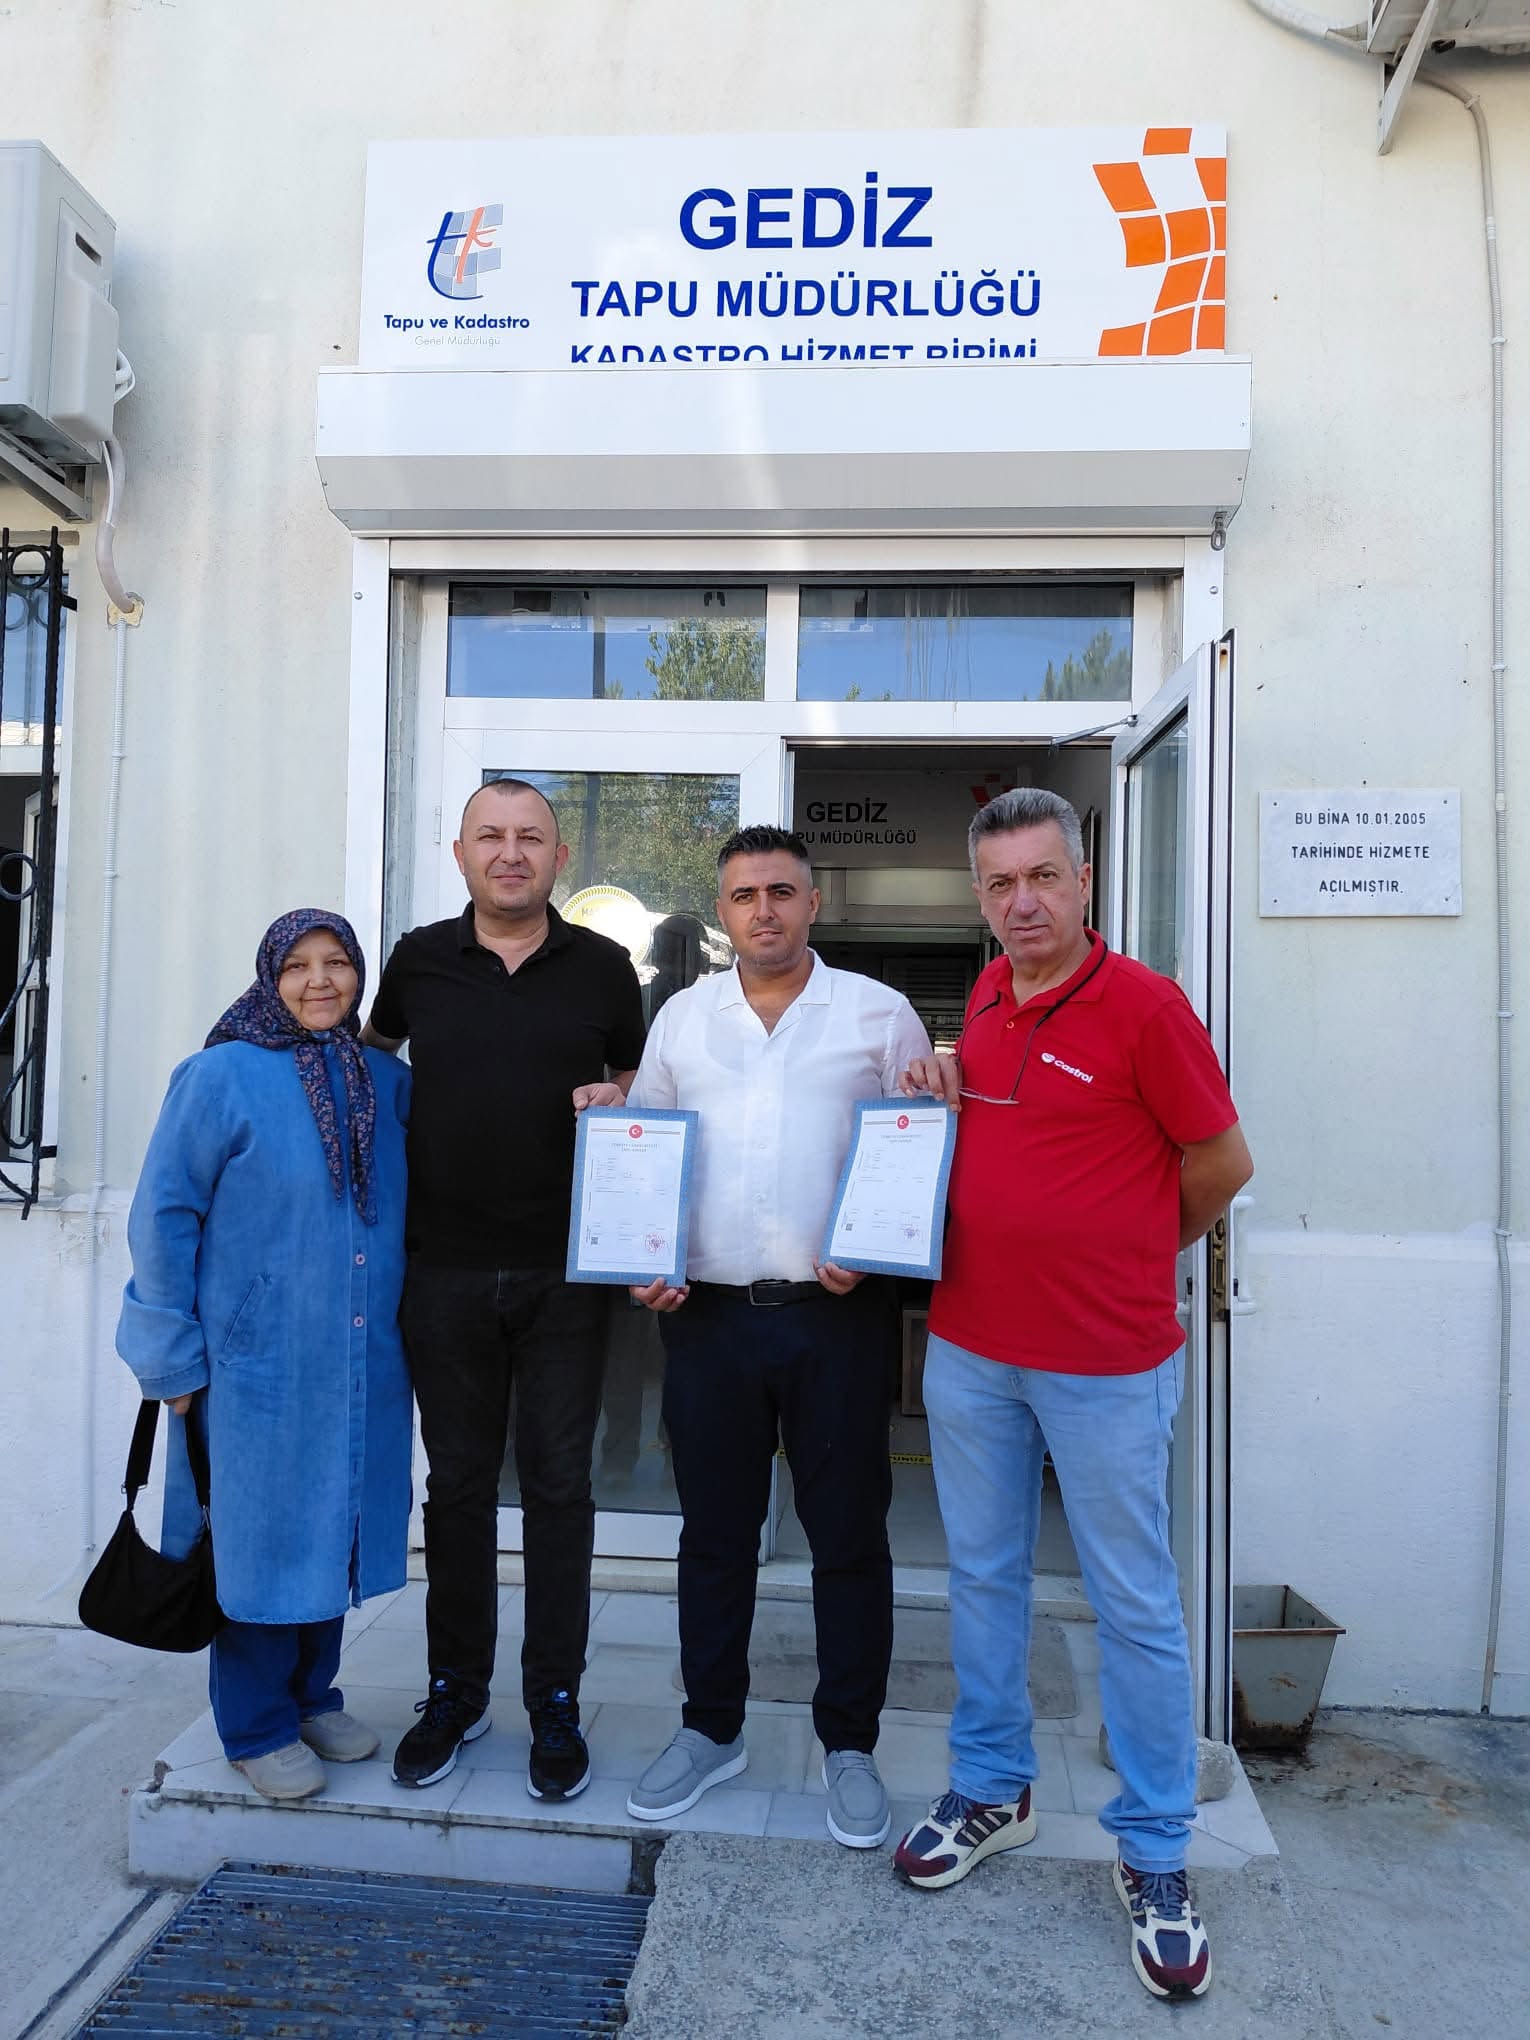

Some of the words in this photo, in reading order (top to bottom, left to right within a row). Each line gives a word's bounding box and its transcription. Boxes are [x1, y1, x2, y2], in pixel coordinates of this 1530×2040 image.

[679, 171, 933, 251] GEDİZ
[571, 280, 698, 318] TAPU
[716, 268, 1041, 317] MÜDÜRLÜĞÜ
[383, 314, 424, 332] Tapu
[429, 318, 449, 329] ve
[454, 313, 530, 329] Kadastro
[414, 335, 444, 346] Genel
[806, 797, 888, 823] GEDİZ
[1295, 812, 1313, 825] BU
[1318, 808, 1350, 825] BİNA
[1355, 812, 1426, 826] 10.01.2005
[820, 829, 917, 844] MÜDÜRLÜĞÜ
[1291, 842, 1364, 859] TARİHİNDE
[1369, 842, 1430, 859] HİZMETE
